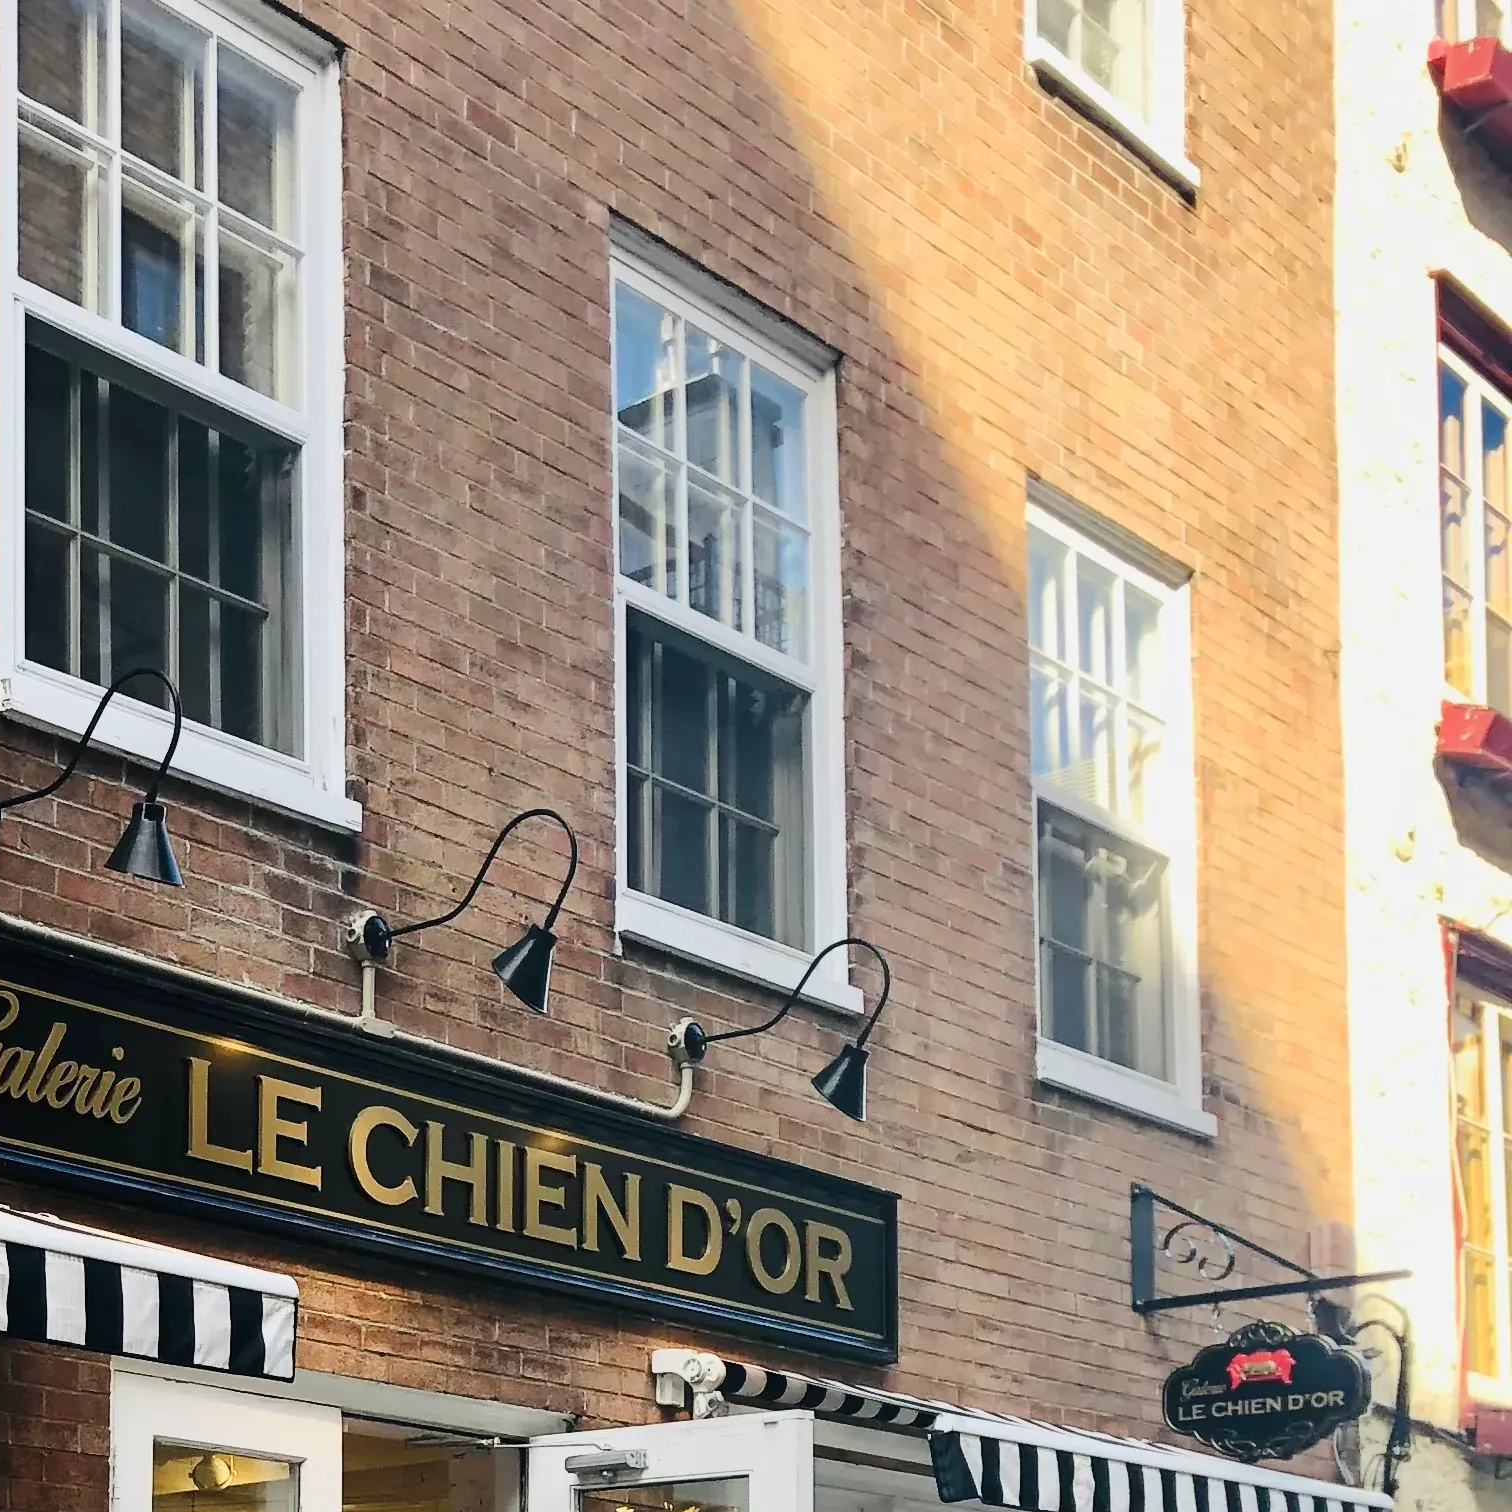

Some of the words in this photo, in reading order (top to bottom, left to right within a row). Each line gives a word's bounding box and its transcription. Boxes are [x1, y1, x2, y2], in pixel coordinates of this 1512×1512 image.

[186, 1057, 323, 1192] LE
[348, 1105, 642, 1262] CHIEN
[667, 1182, 856, 1311] D'OR
[1178, 1404, 1207, 1422] LE
[1211, 1396, 1282, 1418] CHIEN
[1288, 1390, 1345, 1411] D'OR
